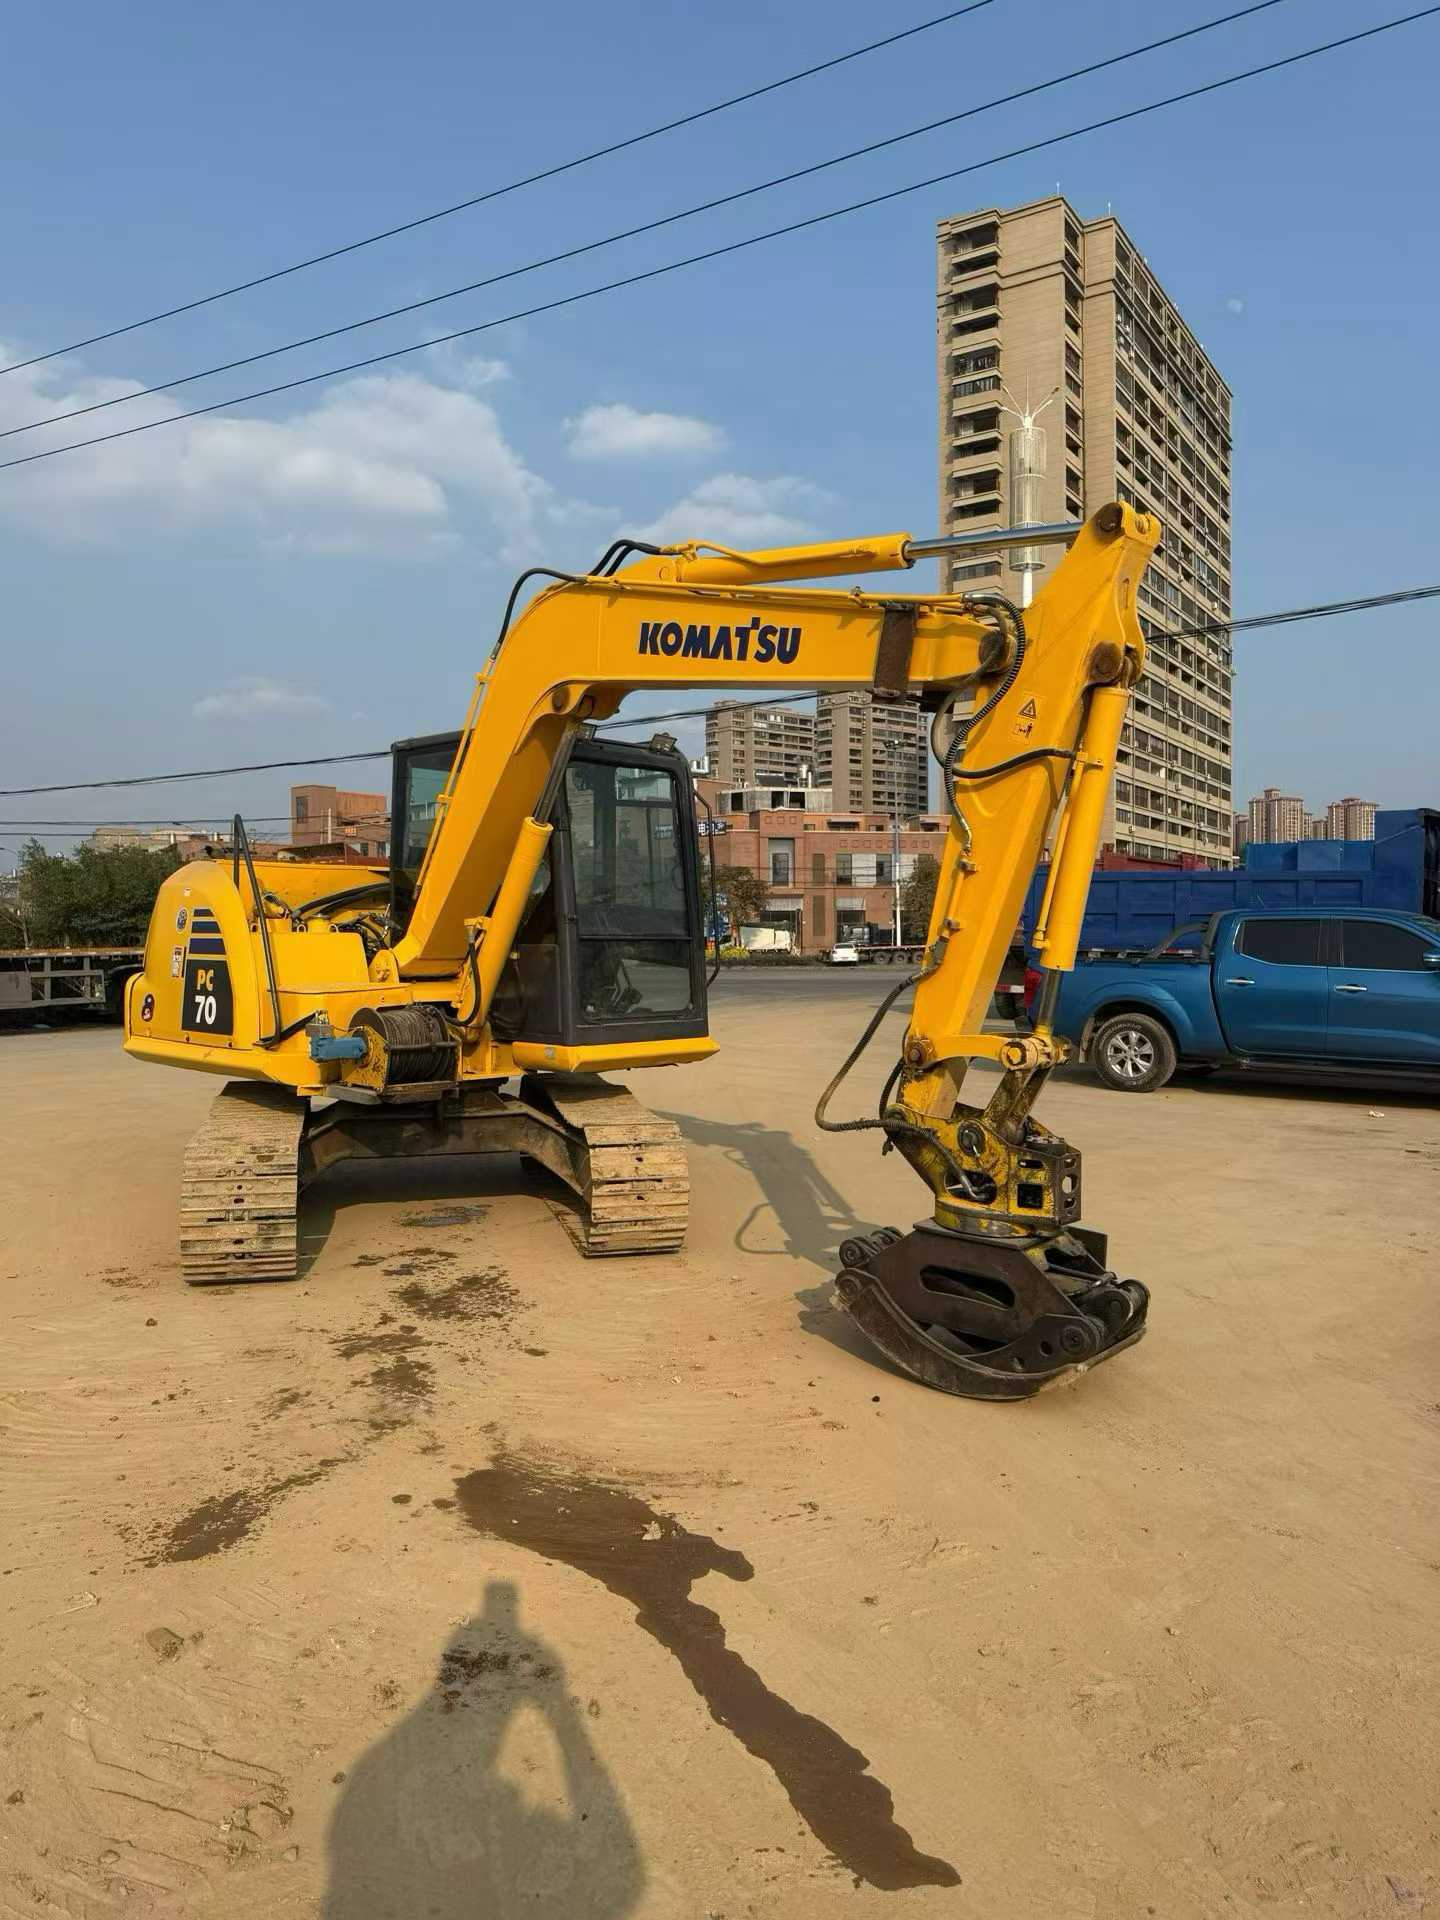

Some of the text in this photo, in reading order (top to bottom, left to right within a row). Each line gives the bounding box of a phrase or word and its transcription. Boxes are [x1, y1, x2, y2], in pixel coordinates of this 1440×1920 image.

[639, 616, 802, 664] KOMATSU
[196, 969, 214, 991] PC
[195, 995, 217, 1025] 70
